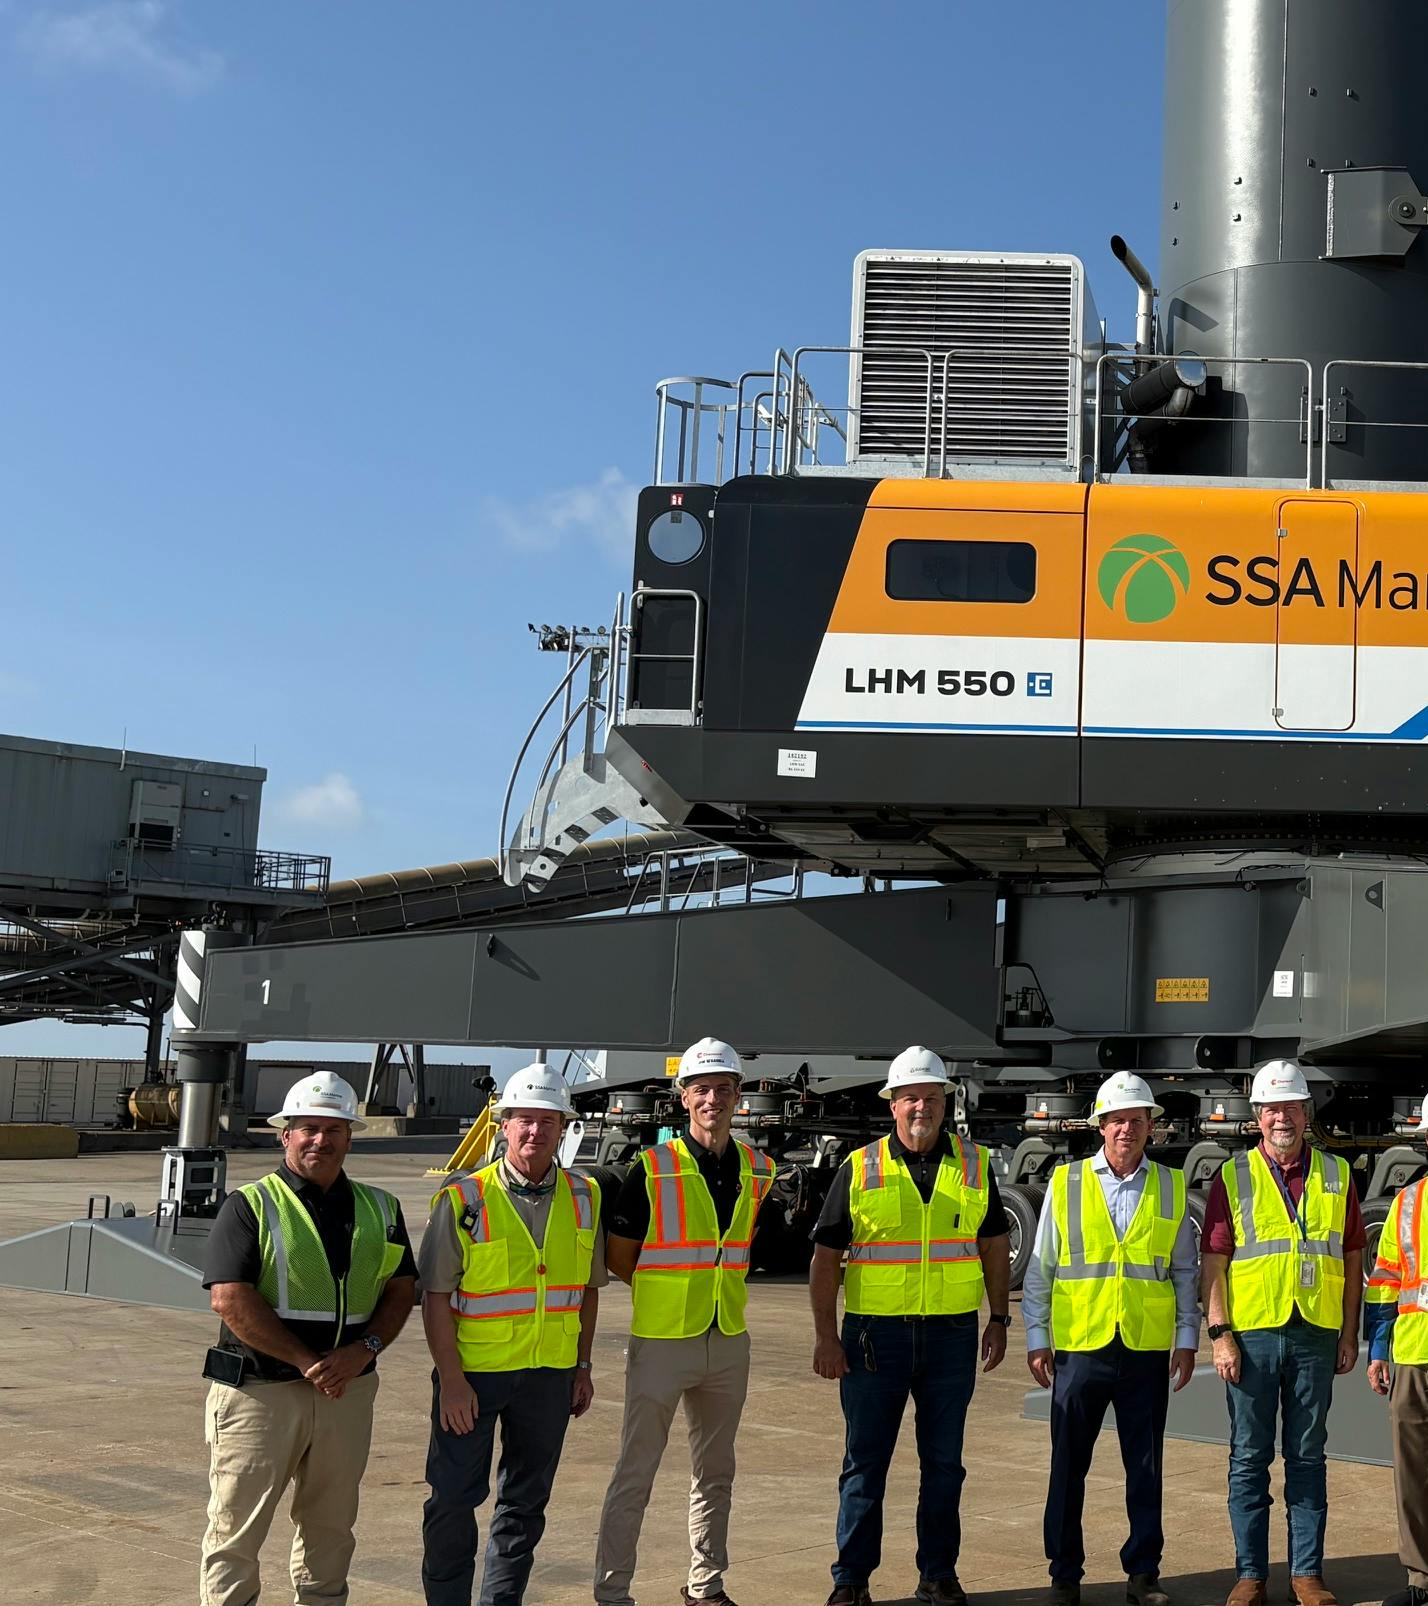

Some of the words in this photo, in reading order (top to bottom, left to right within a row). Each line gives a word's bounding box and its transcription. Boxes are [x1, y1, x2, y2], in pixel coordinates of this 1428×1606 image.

[1205, 555, 1325, 607] SSA
[845, 668, 926, 694] LHM
[937, 670, 1016, 697] 550
[262, 979, 271, 1005] 1
